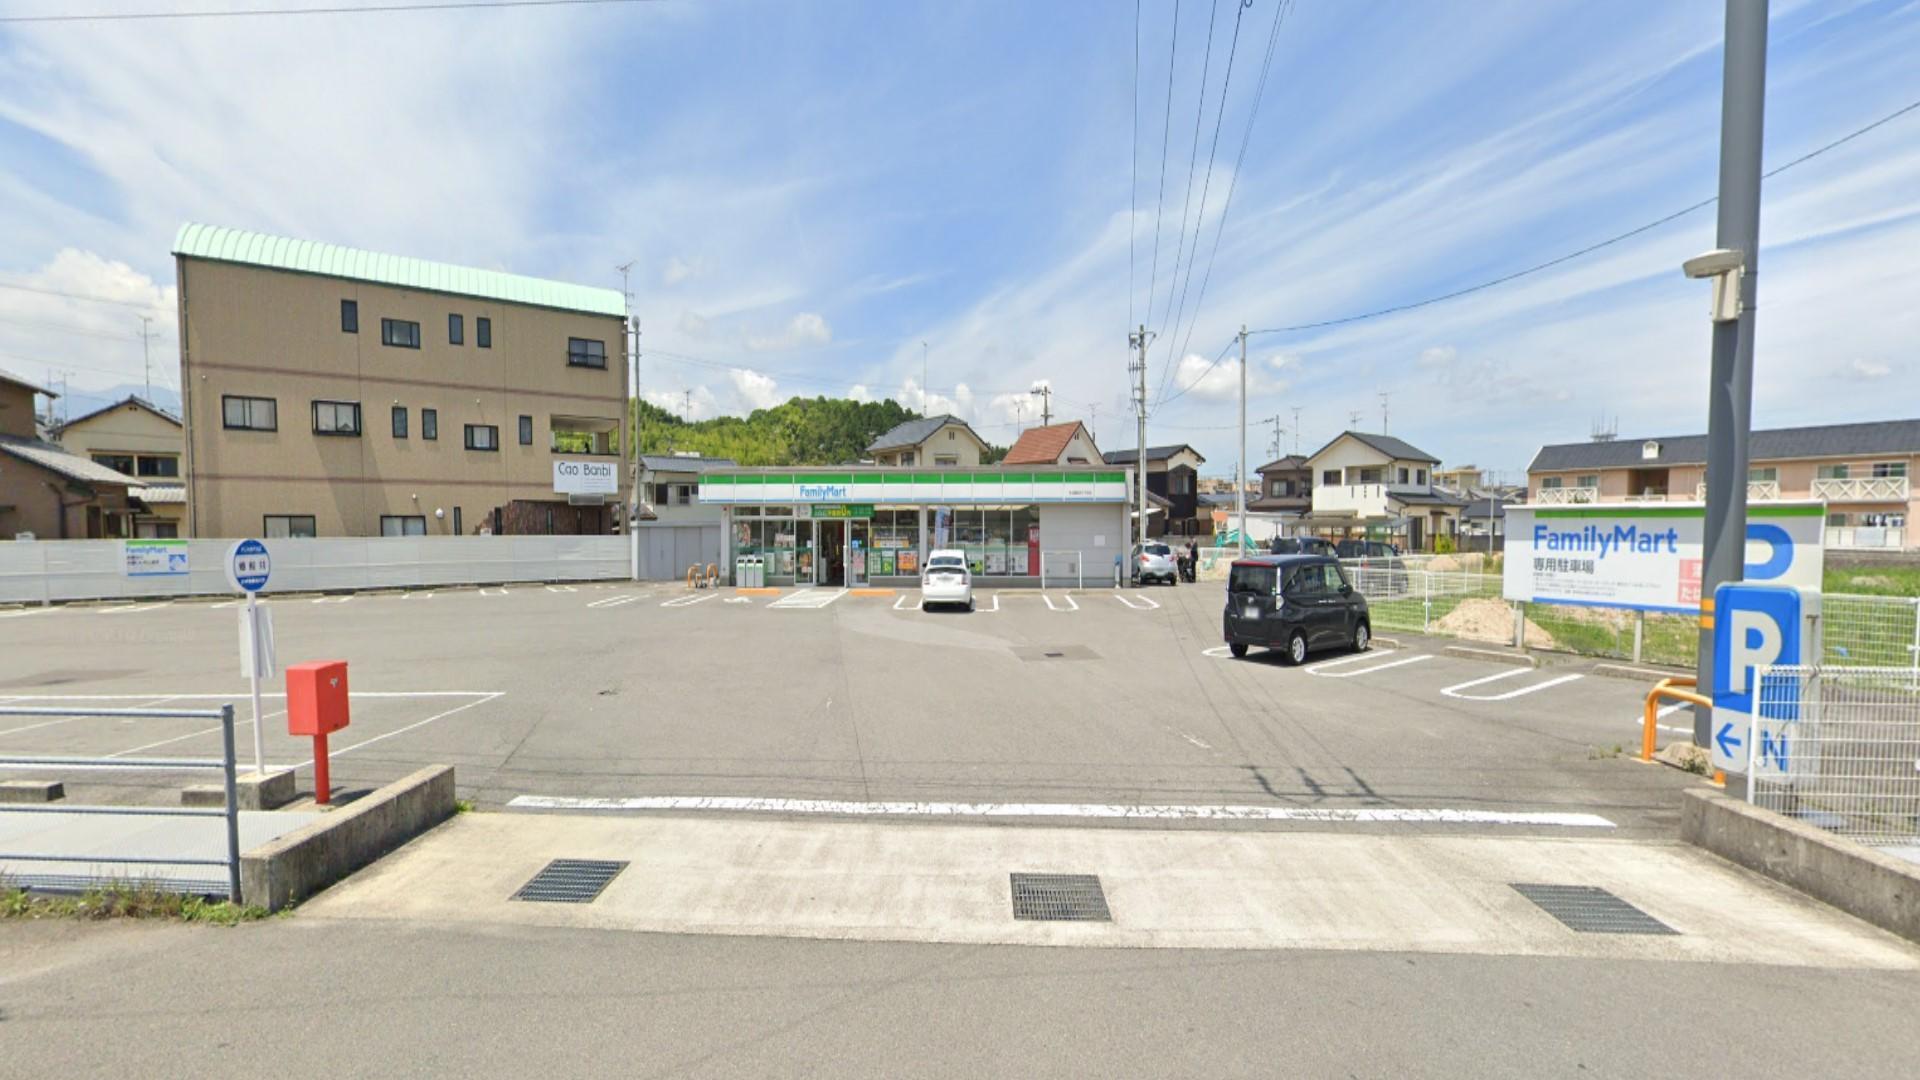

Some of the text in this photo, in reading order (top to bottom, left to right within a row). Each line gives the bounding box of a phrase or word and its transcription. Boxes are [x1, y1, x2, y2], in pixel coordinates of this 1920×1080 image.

[558, 462, 579, 476] Cao
[799, 485, 846, 500] FamilyMart
[1533, 525, 1678, 559] FamilyMart
[1533, 557, 1595, 575] 専用駐車場
[1730, 609, 1783, 695] P
